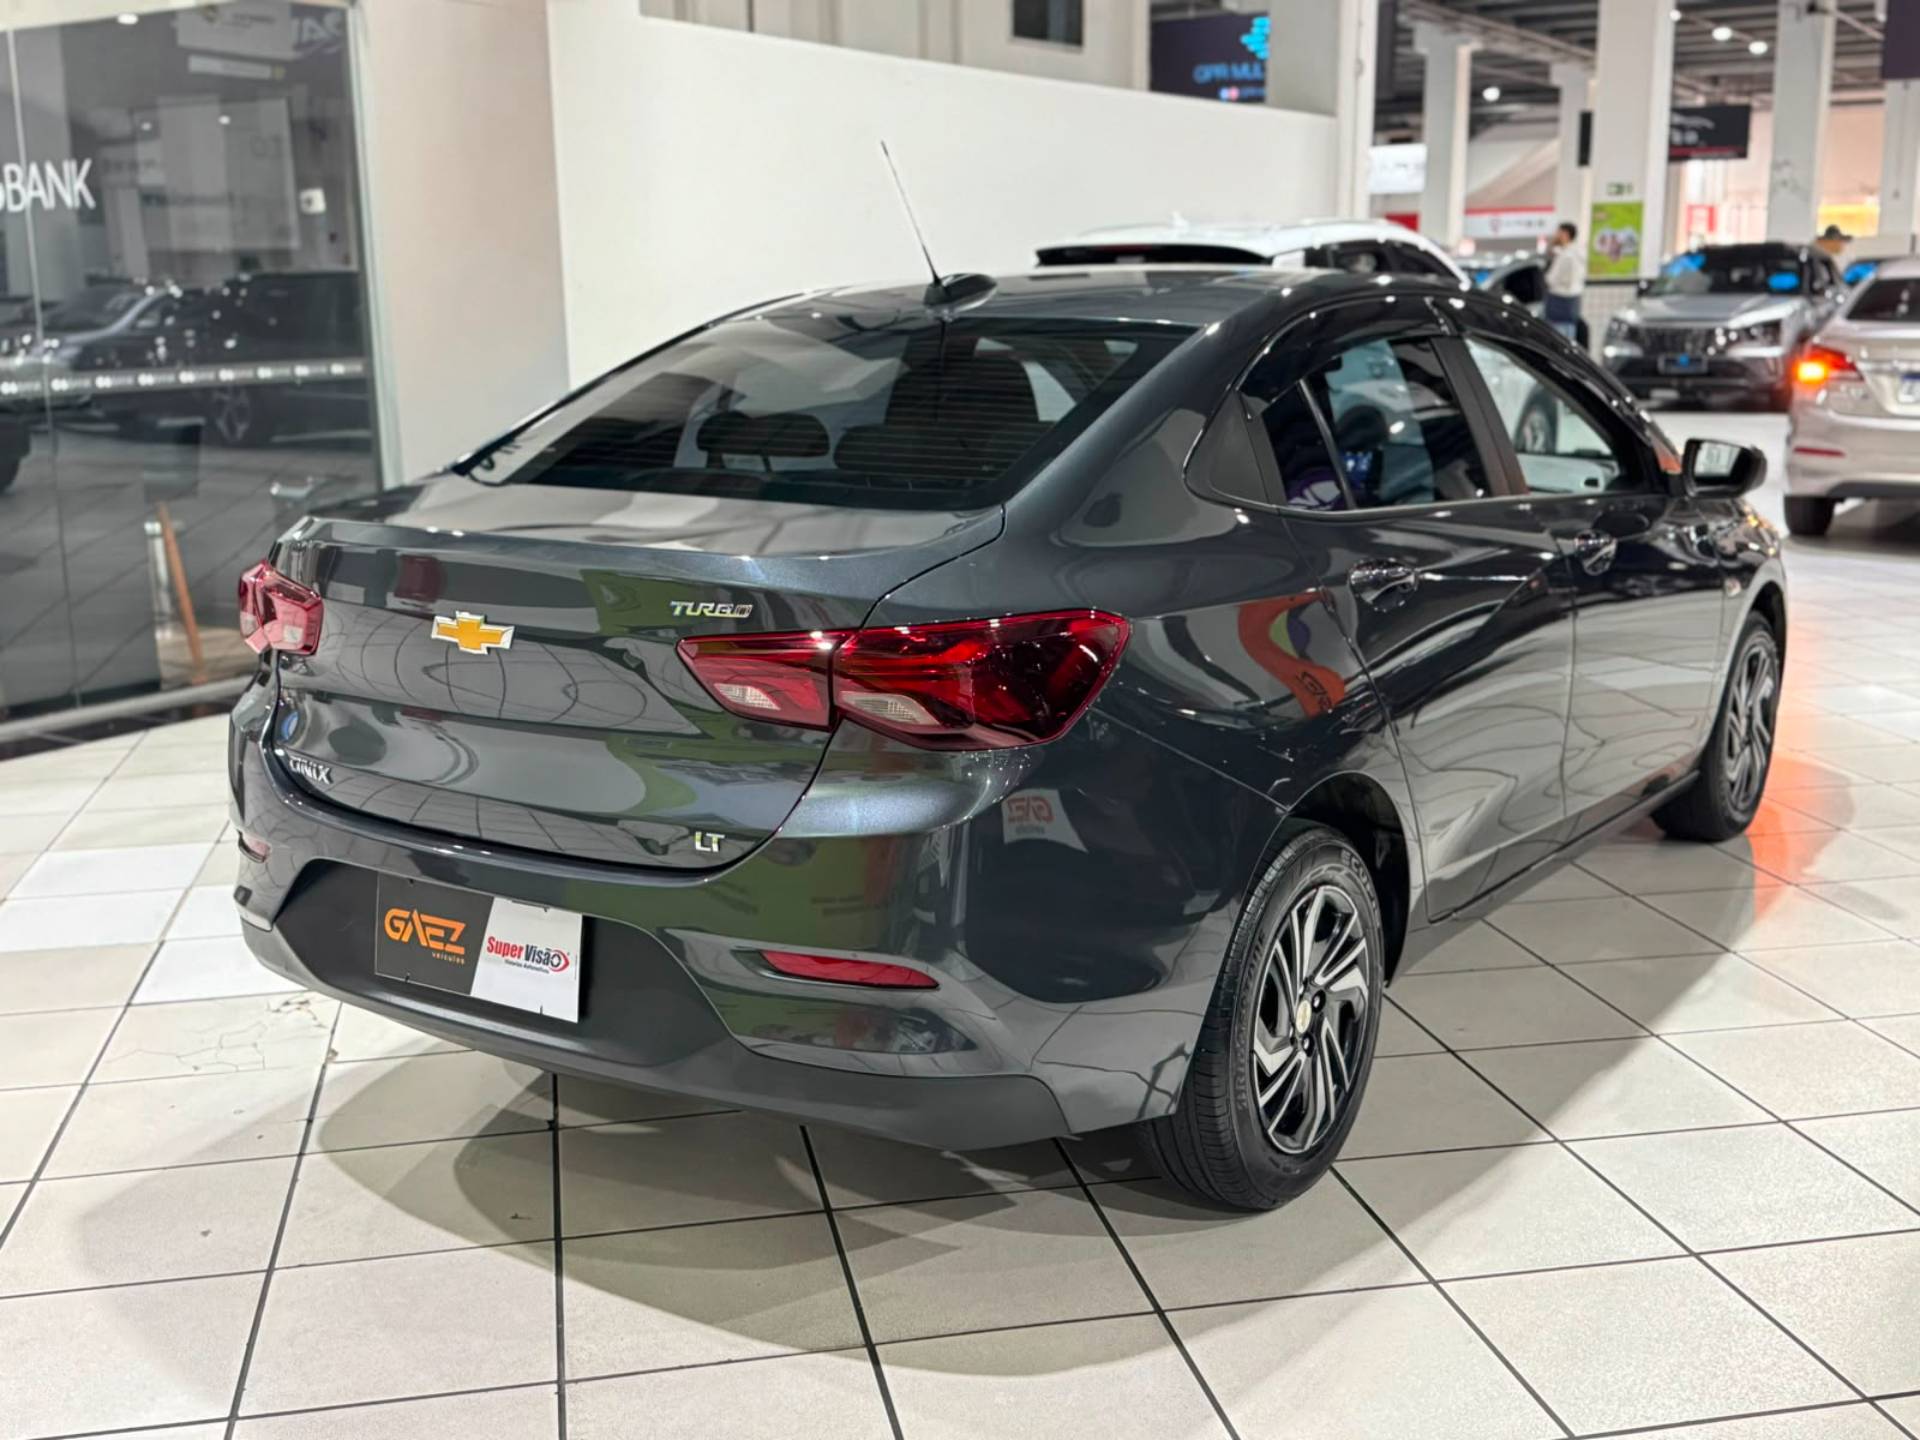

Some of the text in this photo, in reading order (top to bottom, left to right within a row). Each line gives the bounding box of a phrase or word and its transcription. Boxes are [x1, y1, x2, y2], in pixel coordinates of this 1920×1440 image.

[0, 158, 97, 213] BANK
[669, 600, 753, 619] TURBO
[289, 755, 331, 785] ONIX
[695, 831, 726, 852] LT
[384, 907, 466, 956] GAEZ
